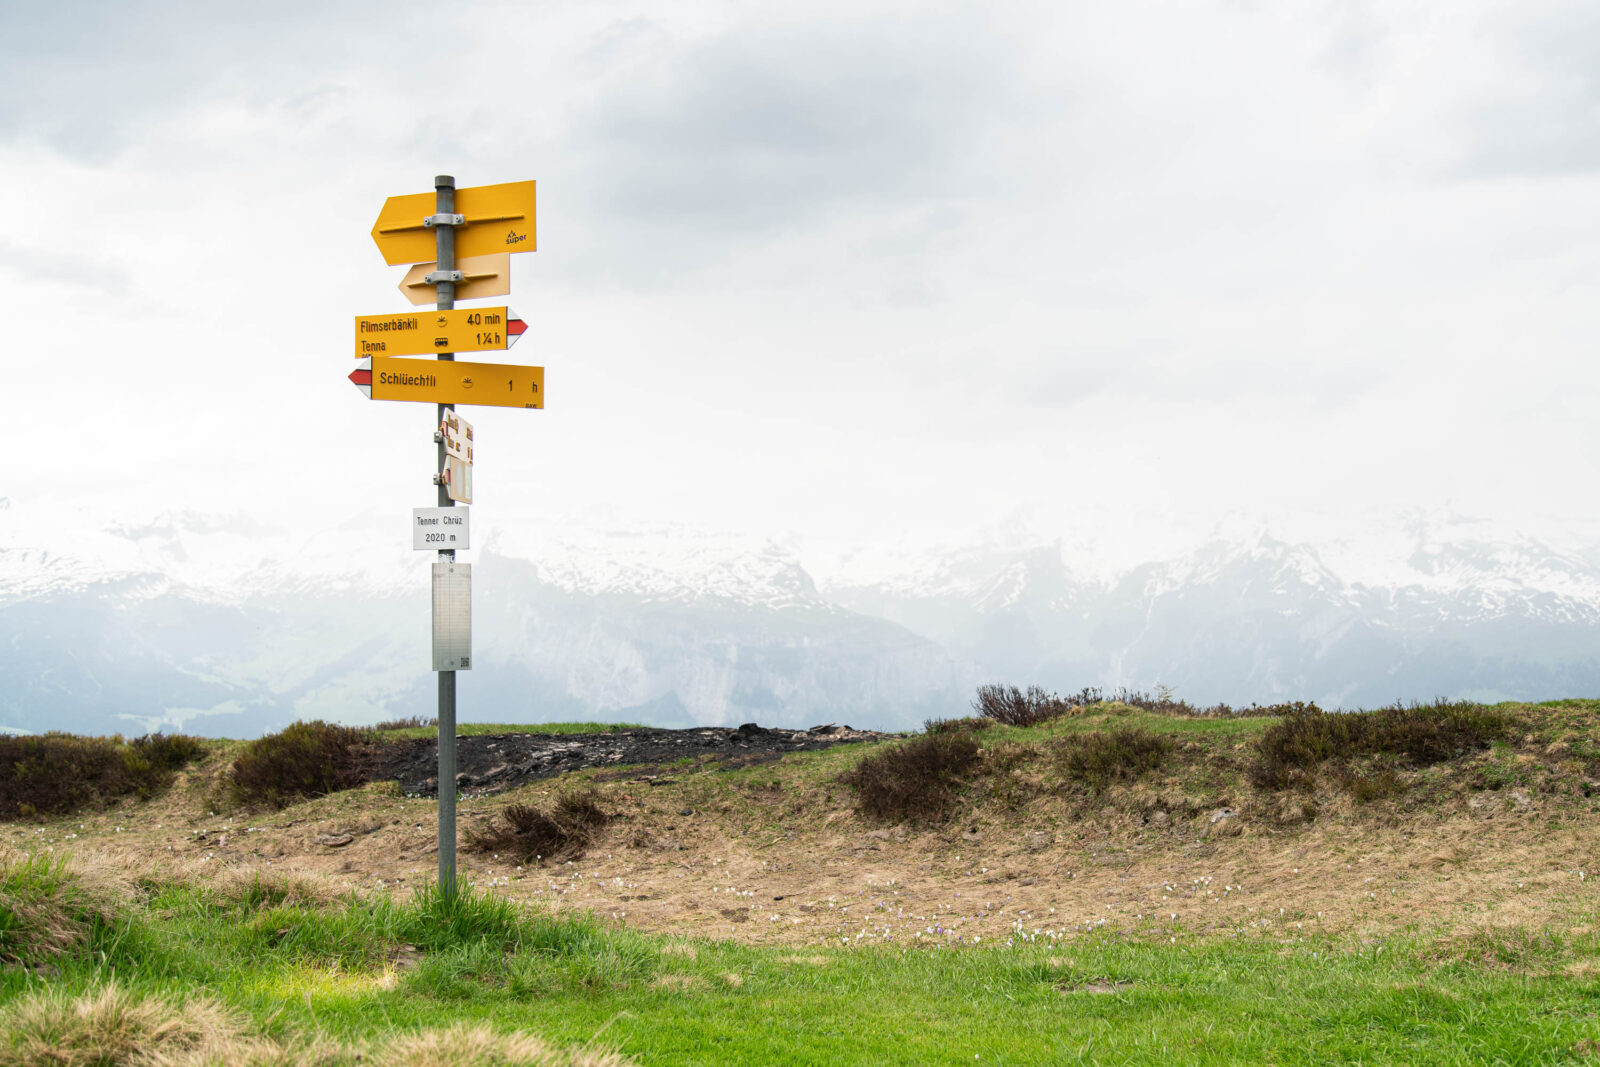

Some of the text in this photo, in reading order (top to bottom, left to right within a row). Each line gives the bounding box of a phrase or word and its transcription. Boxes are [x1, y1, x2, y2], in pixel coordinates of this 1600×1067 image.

[506, 234, 527, 244] super
[360, 312, 500, 333] Flimserbänkli 40 min
[361, 340, 386, 352] Tenna
[494, 332, 500, 344] h
[379, 371, 538, 393] Schlüechtli 1 h
[417, 515, 463, 526] Tenner Chrüz
[425, 533, 445, 542] 2020
